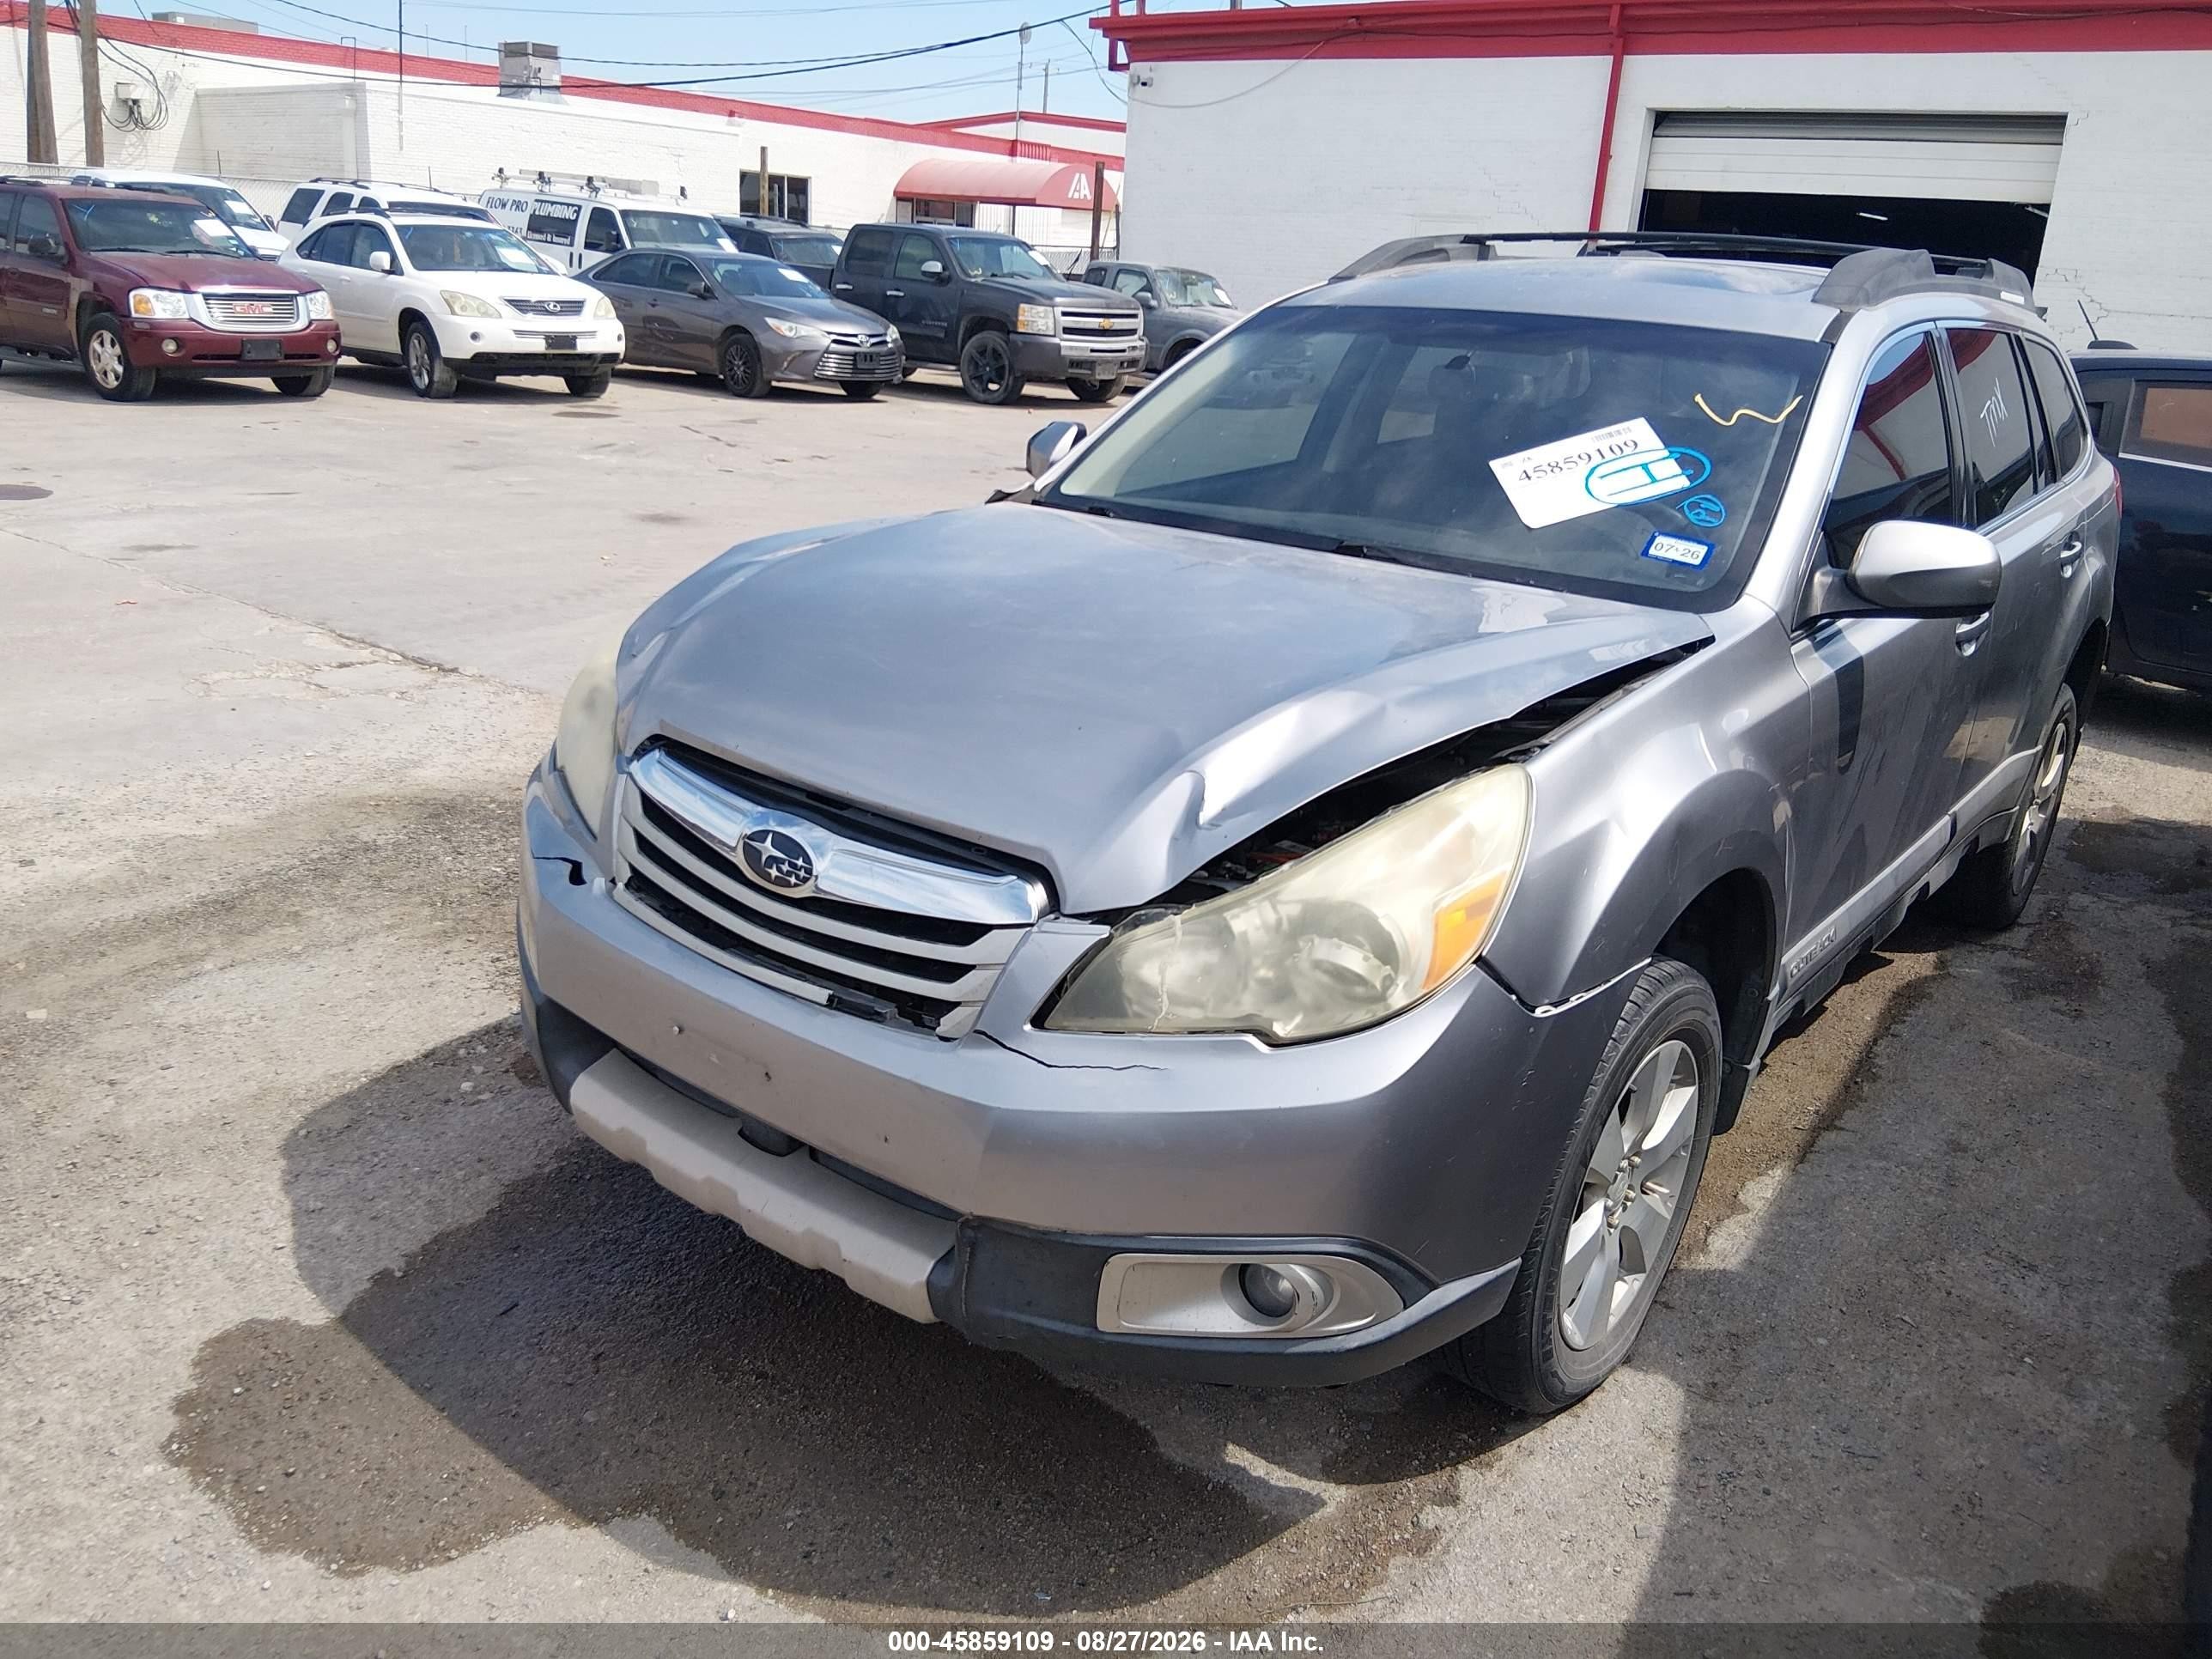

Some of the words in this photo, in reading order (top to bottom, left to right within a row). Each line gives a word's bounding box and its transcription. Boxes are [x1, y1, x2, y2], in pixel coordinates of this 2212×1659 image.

[486, 197, 509, 210] FLOW
[509, 199, 529, 213] PRO
[530, 201, 579, 221] PLUMBING
[233, 303, 274, 314] GMC
[1518, 439, 1639, 483] 45859109
